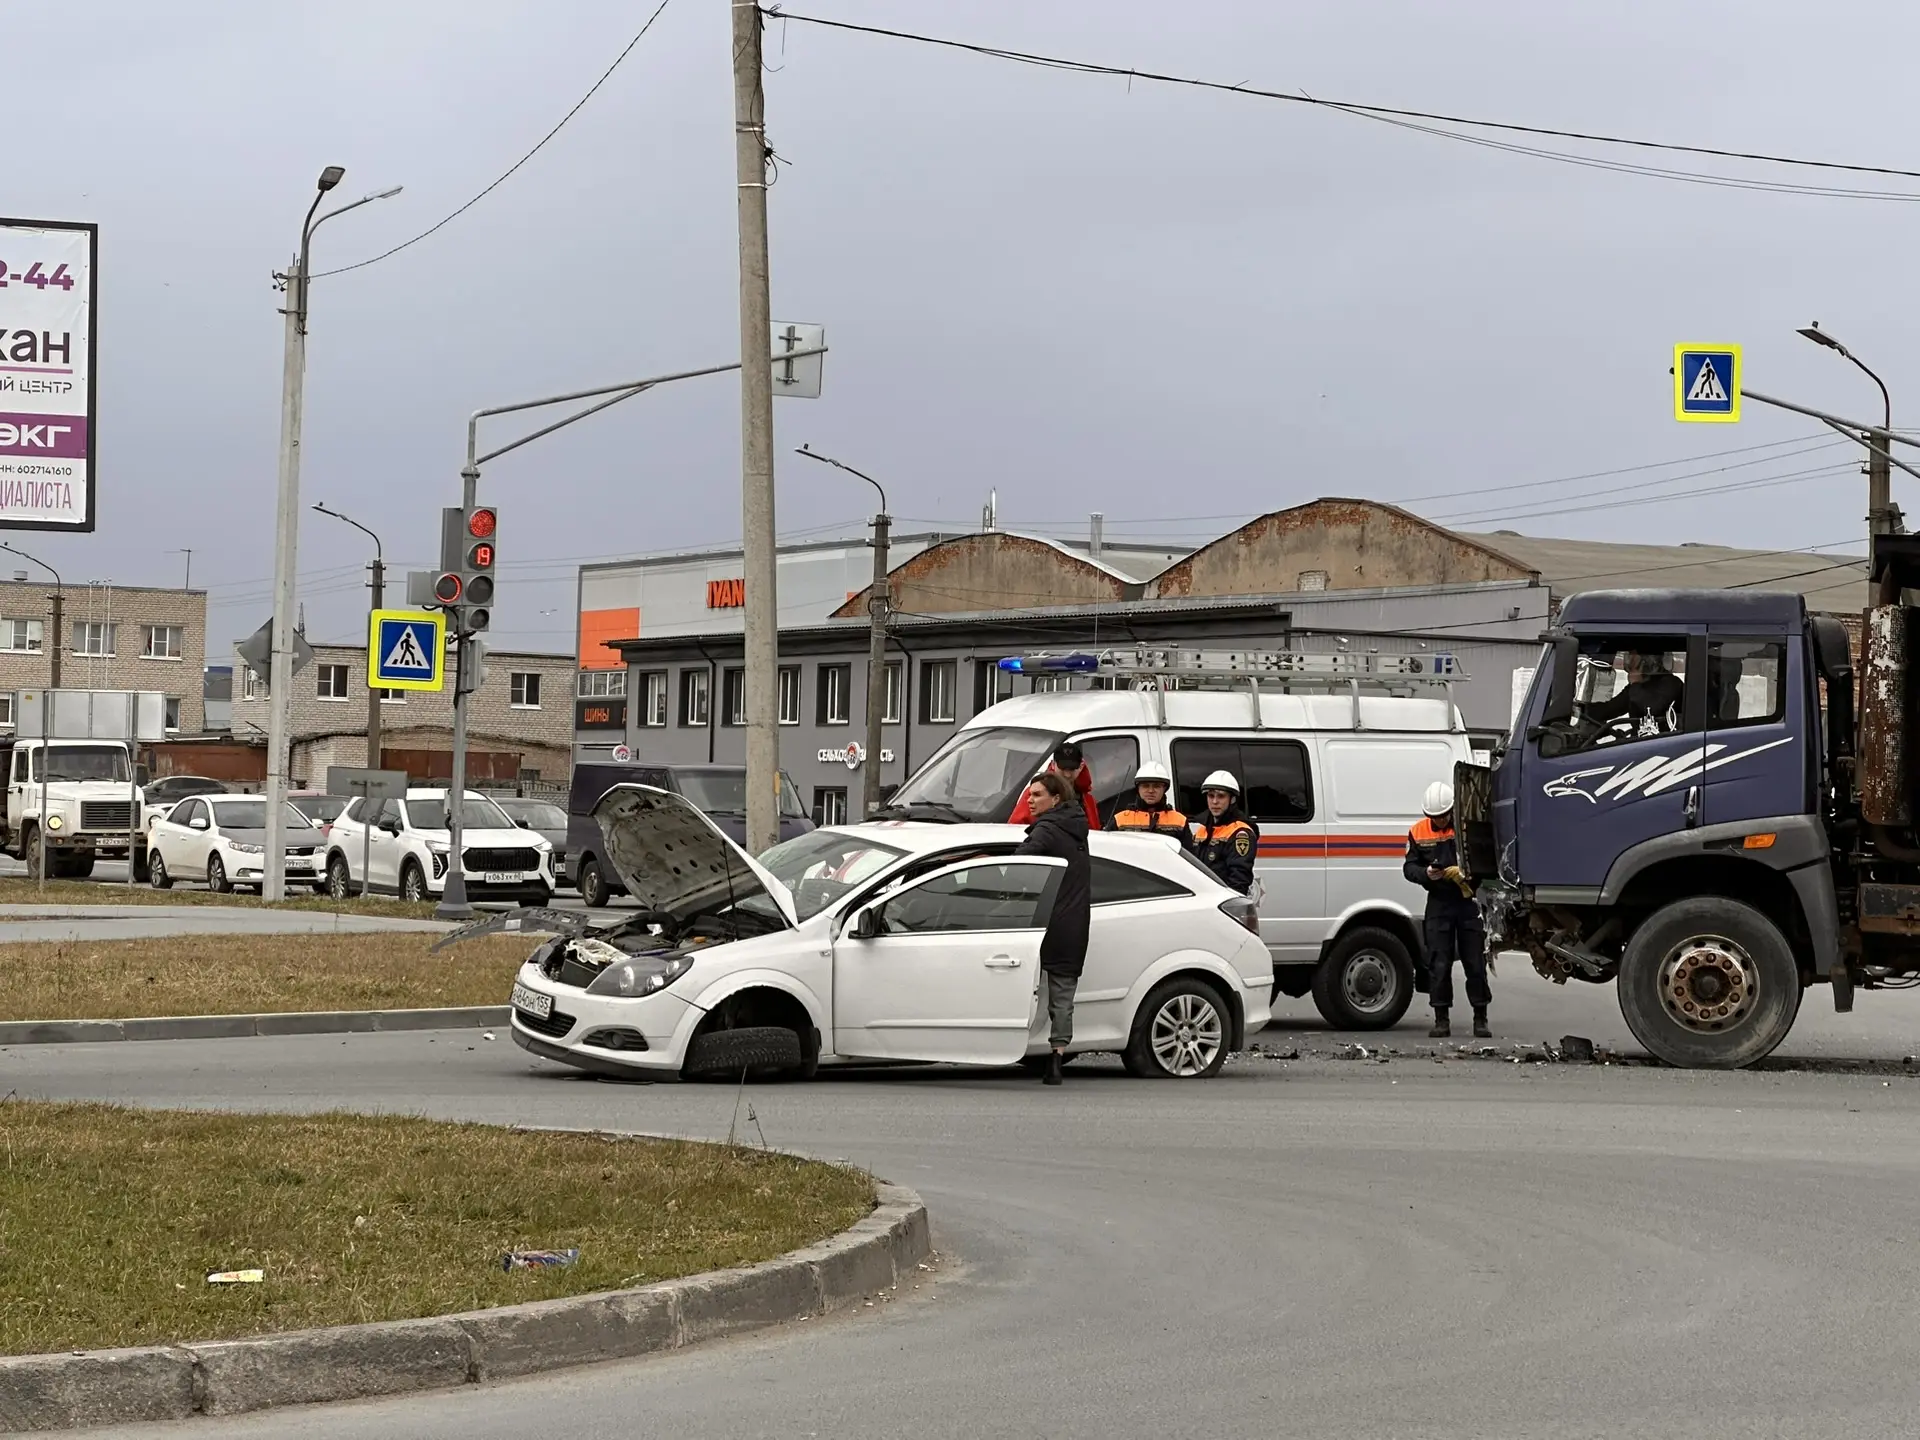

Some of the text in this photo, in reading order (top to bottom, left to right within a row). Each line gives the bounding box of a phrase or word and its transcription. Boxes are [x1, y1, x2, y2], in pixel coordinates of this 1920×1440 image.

[20, 380, 73, 394] ЦЕНТР
[0, 423, 71, 448] ЭКГ
[17, 465, 72, 476] 6027141610
[477, 547, 490, 566] 19
[584, 707, 610, 723] ШИНЫ
